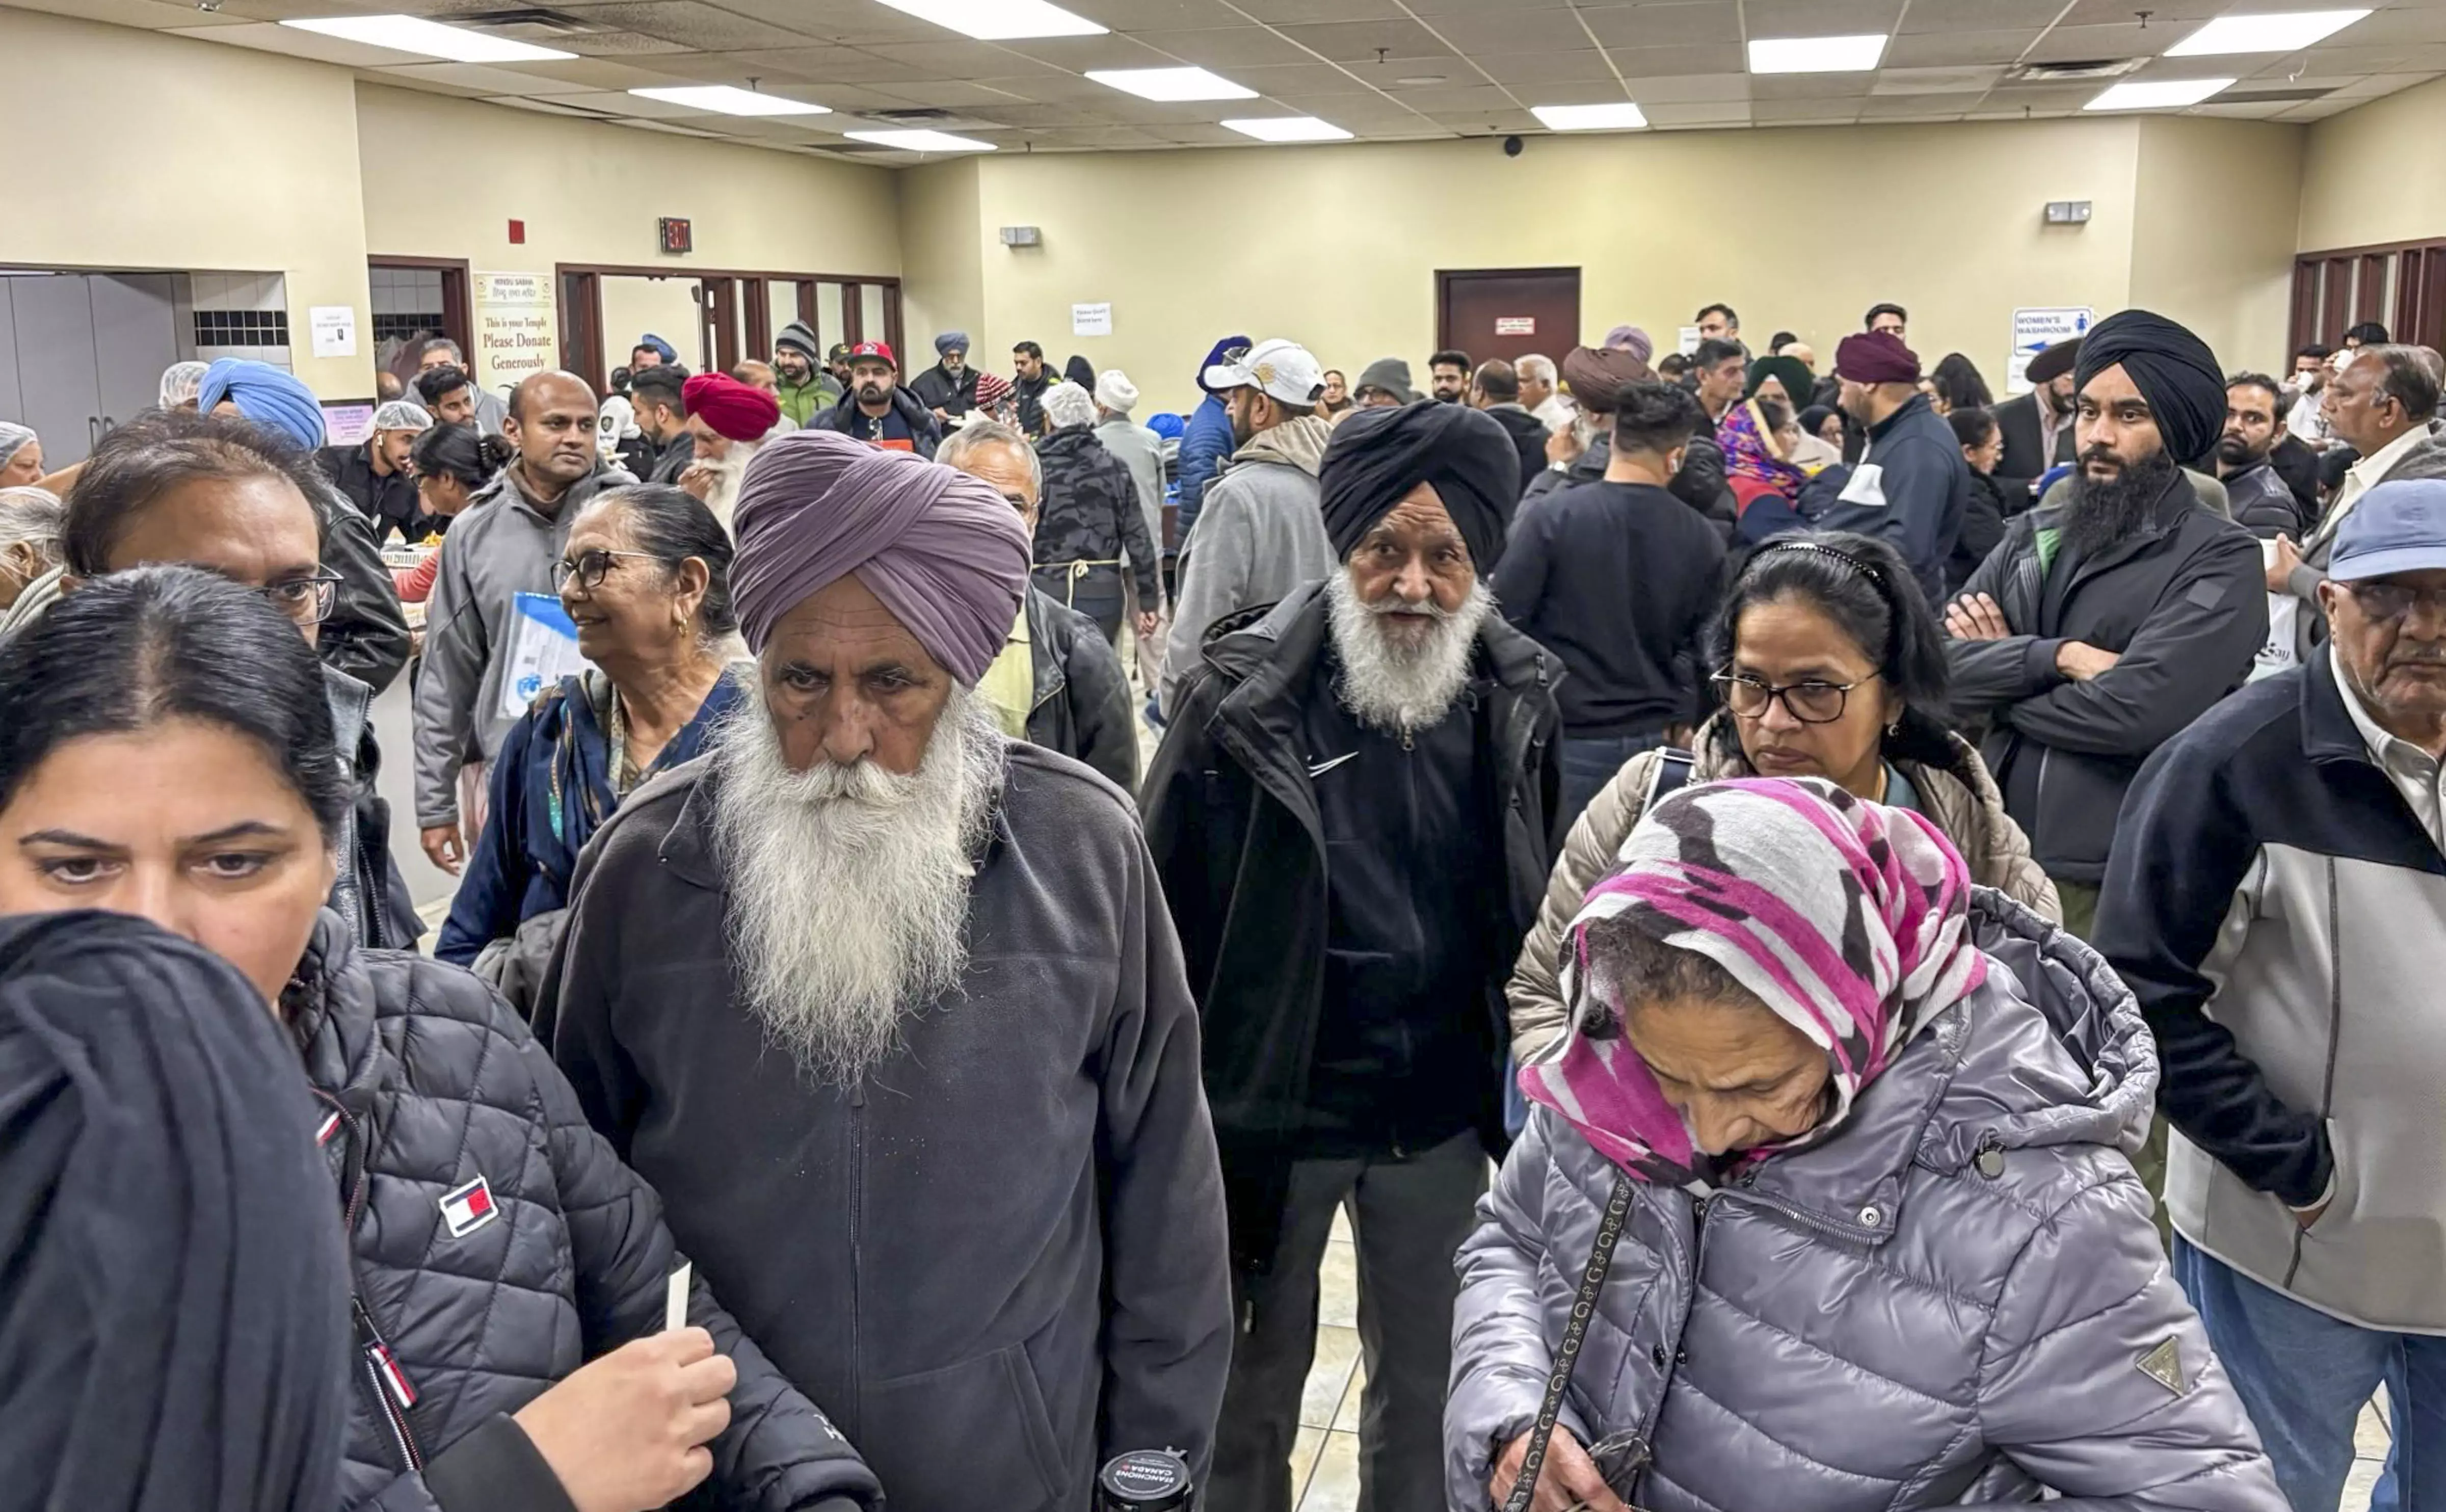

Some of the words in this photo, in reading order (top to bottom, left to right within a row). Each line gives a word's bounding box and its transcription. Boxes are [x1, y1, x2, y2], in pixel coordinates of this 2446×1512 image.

[485, 317, 500, 328] This
[502, 317, 507, 328] is
[509, 320, 523, 330] your
[524, 317, 547, 330] Temple
[484, 333, 514, 348] Please
[516, 333, 551, 348] Donate
[491, 353, 546, 373] Generously
[1115, 1470, 1175, 1483] STANCHIONS
[1131, 1465, 1173, 1476] CANADA
